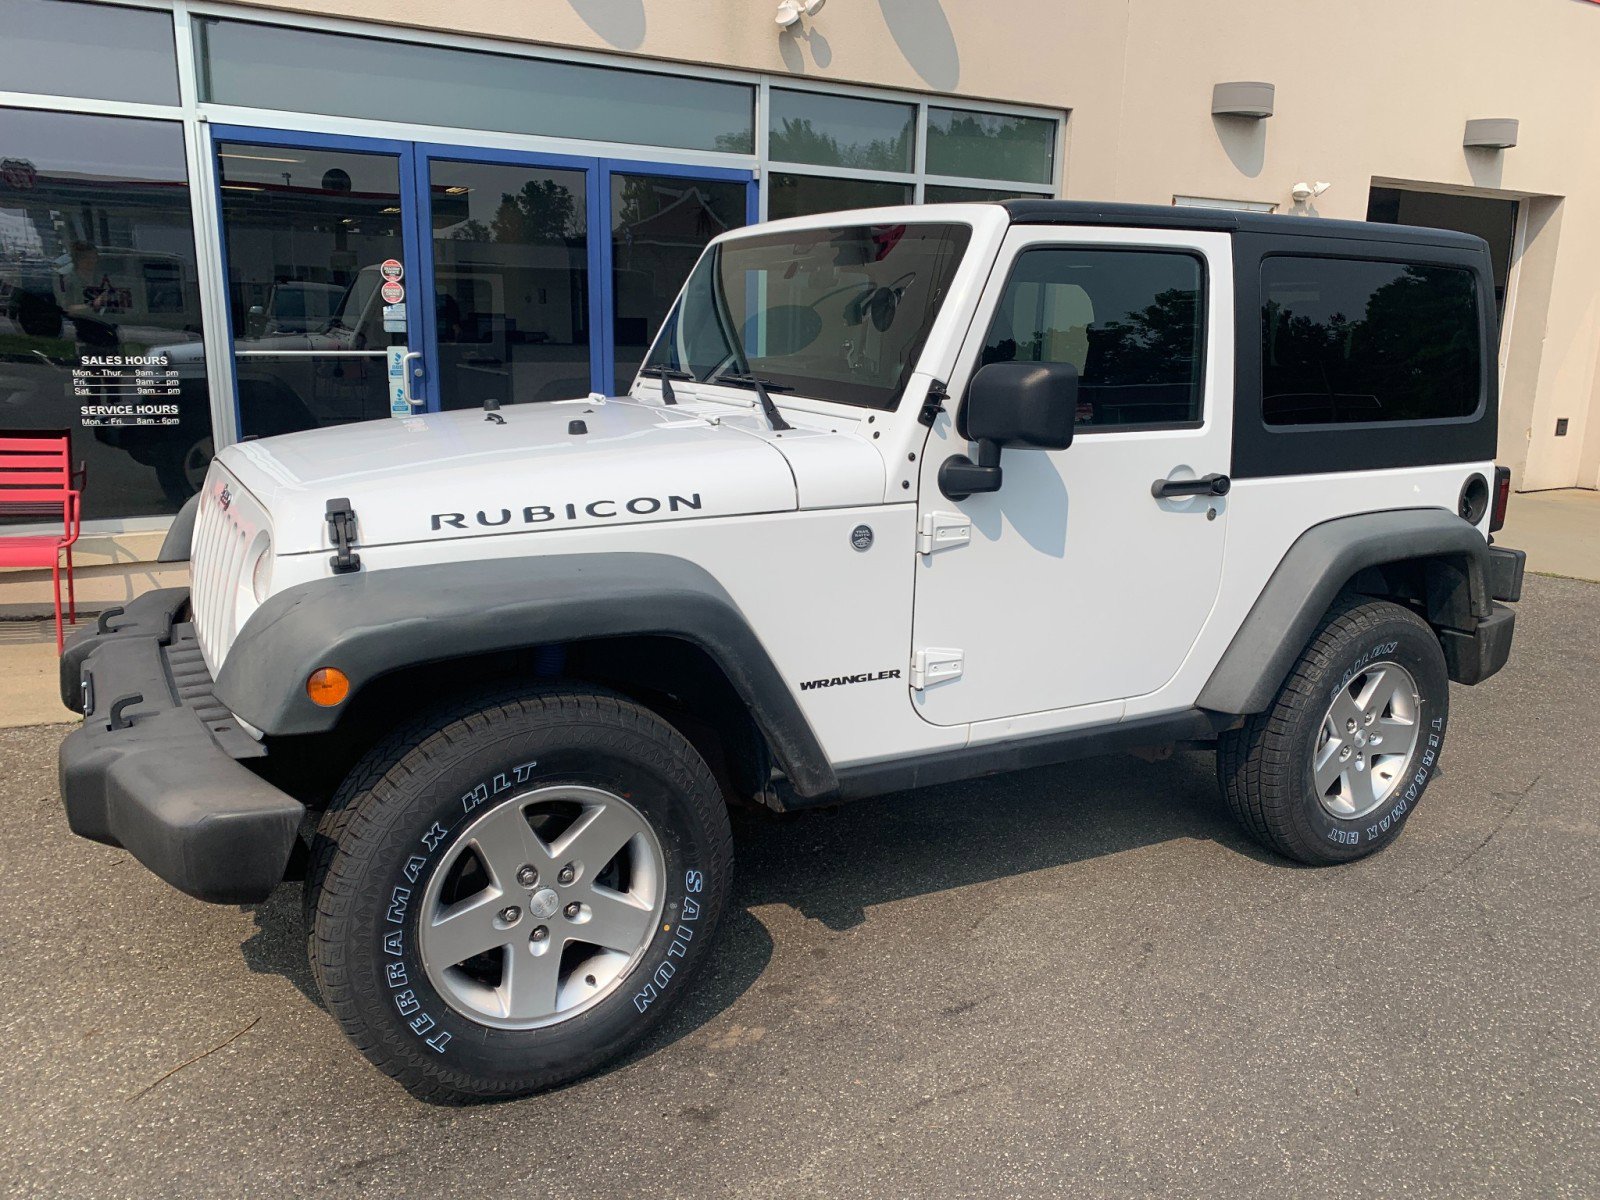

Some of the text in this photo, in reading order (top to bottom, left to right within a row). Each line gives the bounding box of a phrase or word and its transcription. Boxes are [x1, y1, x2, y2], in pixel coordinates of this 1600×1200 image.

[81, 356, 168, 365] SALES HOURS
[73, 378, 87, 386] Fri.
[74, 387, 92, 395] Sat.
[80, 405, 179, 415] SERVICE HOURS
[110, 417, 124, 425] Fri.
[161, 417, 180, 425] 6pm
[430, 493, 703, 531] RUBICON
[799, 669, 901, 691] WRANGLER
[1327, 718, 1443, 844] TERRAMAX HLT
[384, 761, 537, 1053] TERRAMAX HLT
[633, 870, 703, 1014] SAILUN
